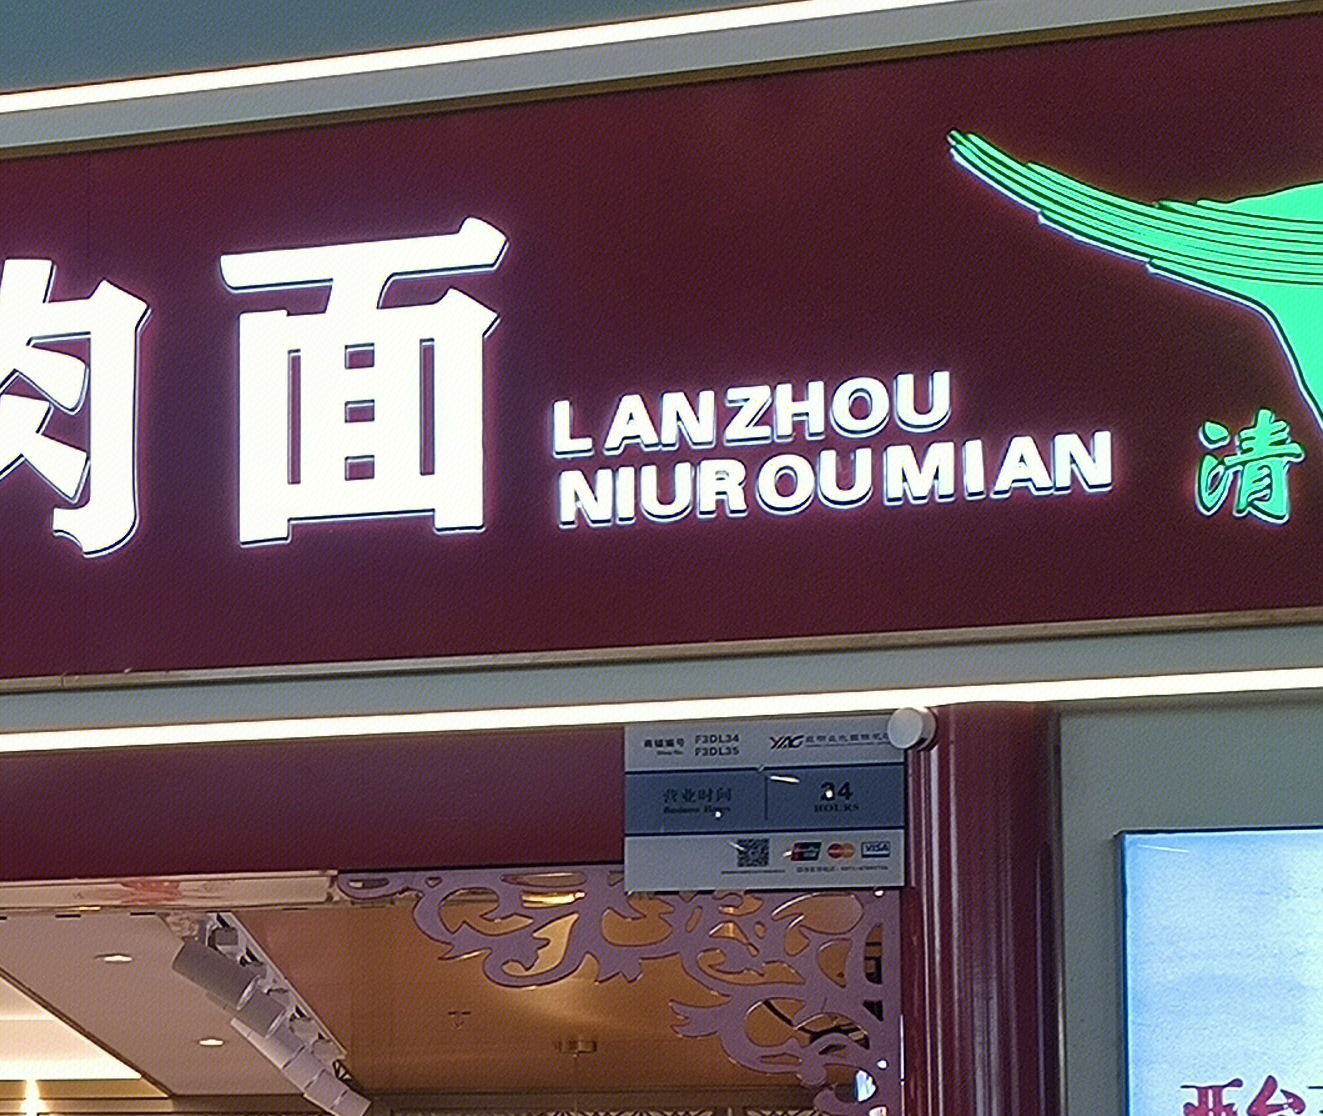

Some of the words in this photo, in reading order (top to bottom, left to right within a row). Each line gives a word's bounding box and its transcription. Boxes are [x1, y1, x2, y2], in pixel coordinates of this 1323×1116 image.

[554, 370, 952, 457] LANZHOU
[558, 432, 1113, 526] NIUROUMIAN
[1196, 409, 1304, 524] 清
